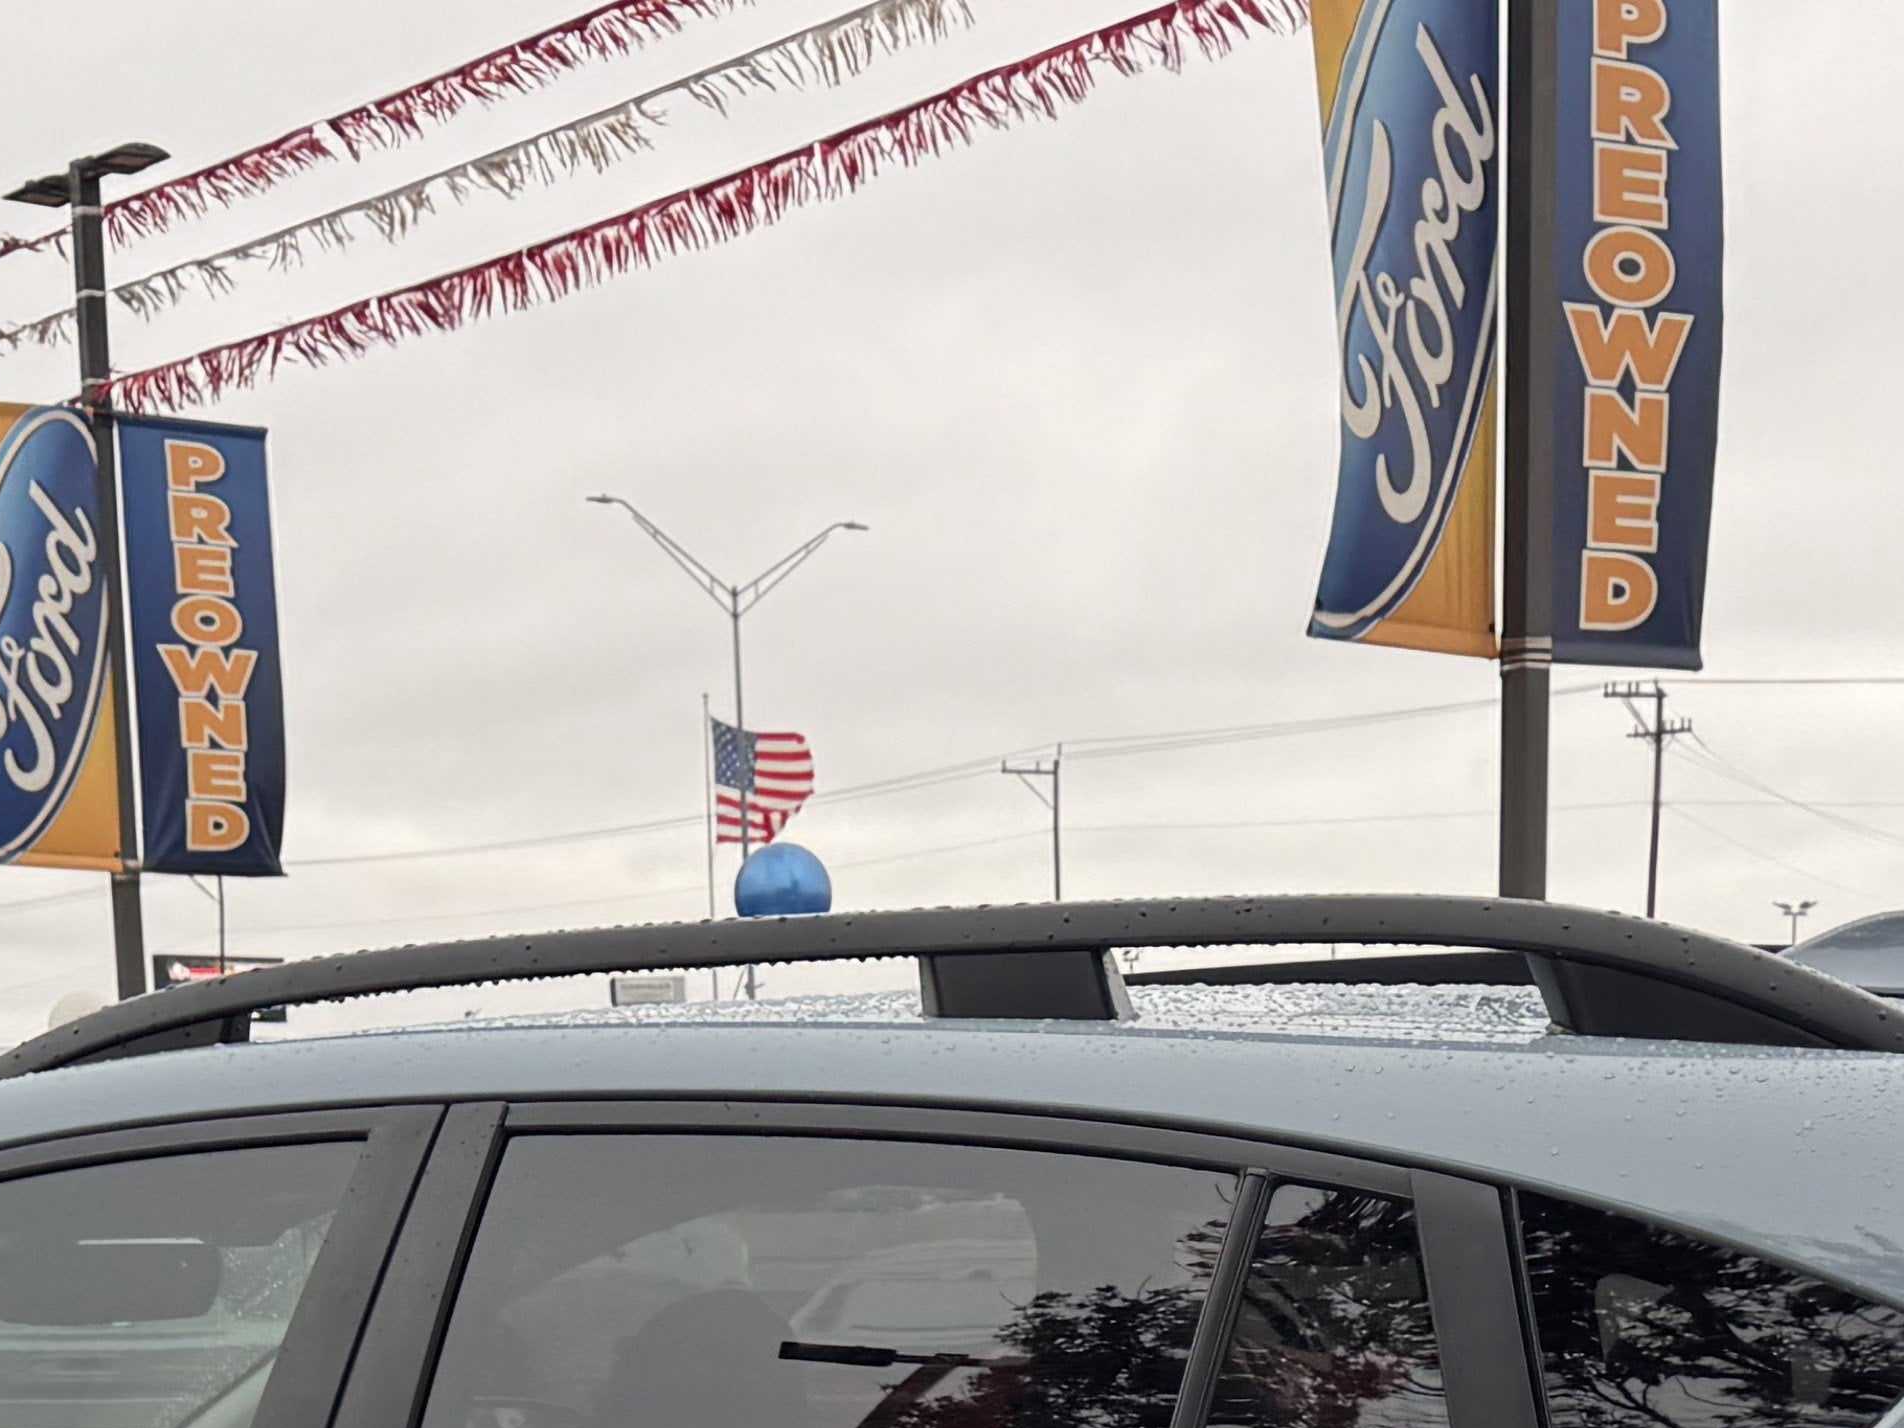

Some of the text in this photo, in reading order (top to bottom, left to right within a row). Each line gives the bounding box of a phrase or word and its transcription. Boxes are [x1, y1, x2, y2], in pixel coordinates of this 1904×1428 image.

[1340, 22, 1495, 524] Ford
[1562, 0, 1694, 630] PREOWNED
[156, 439, 258, 851] PREOWNED
